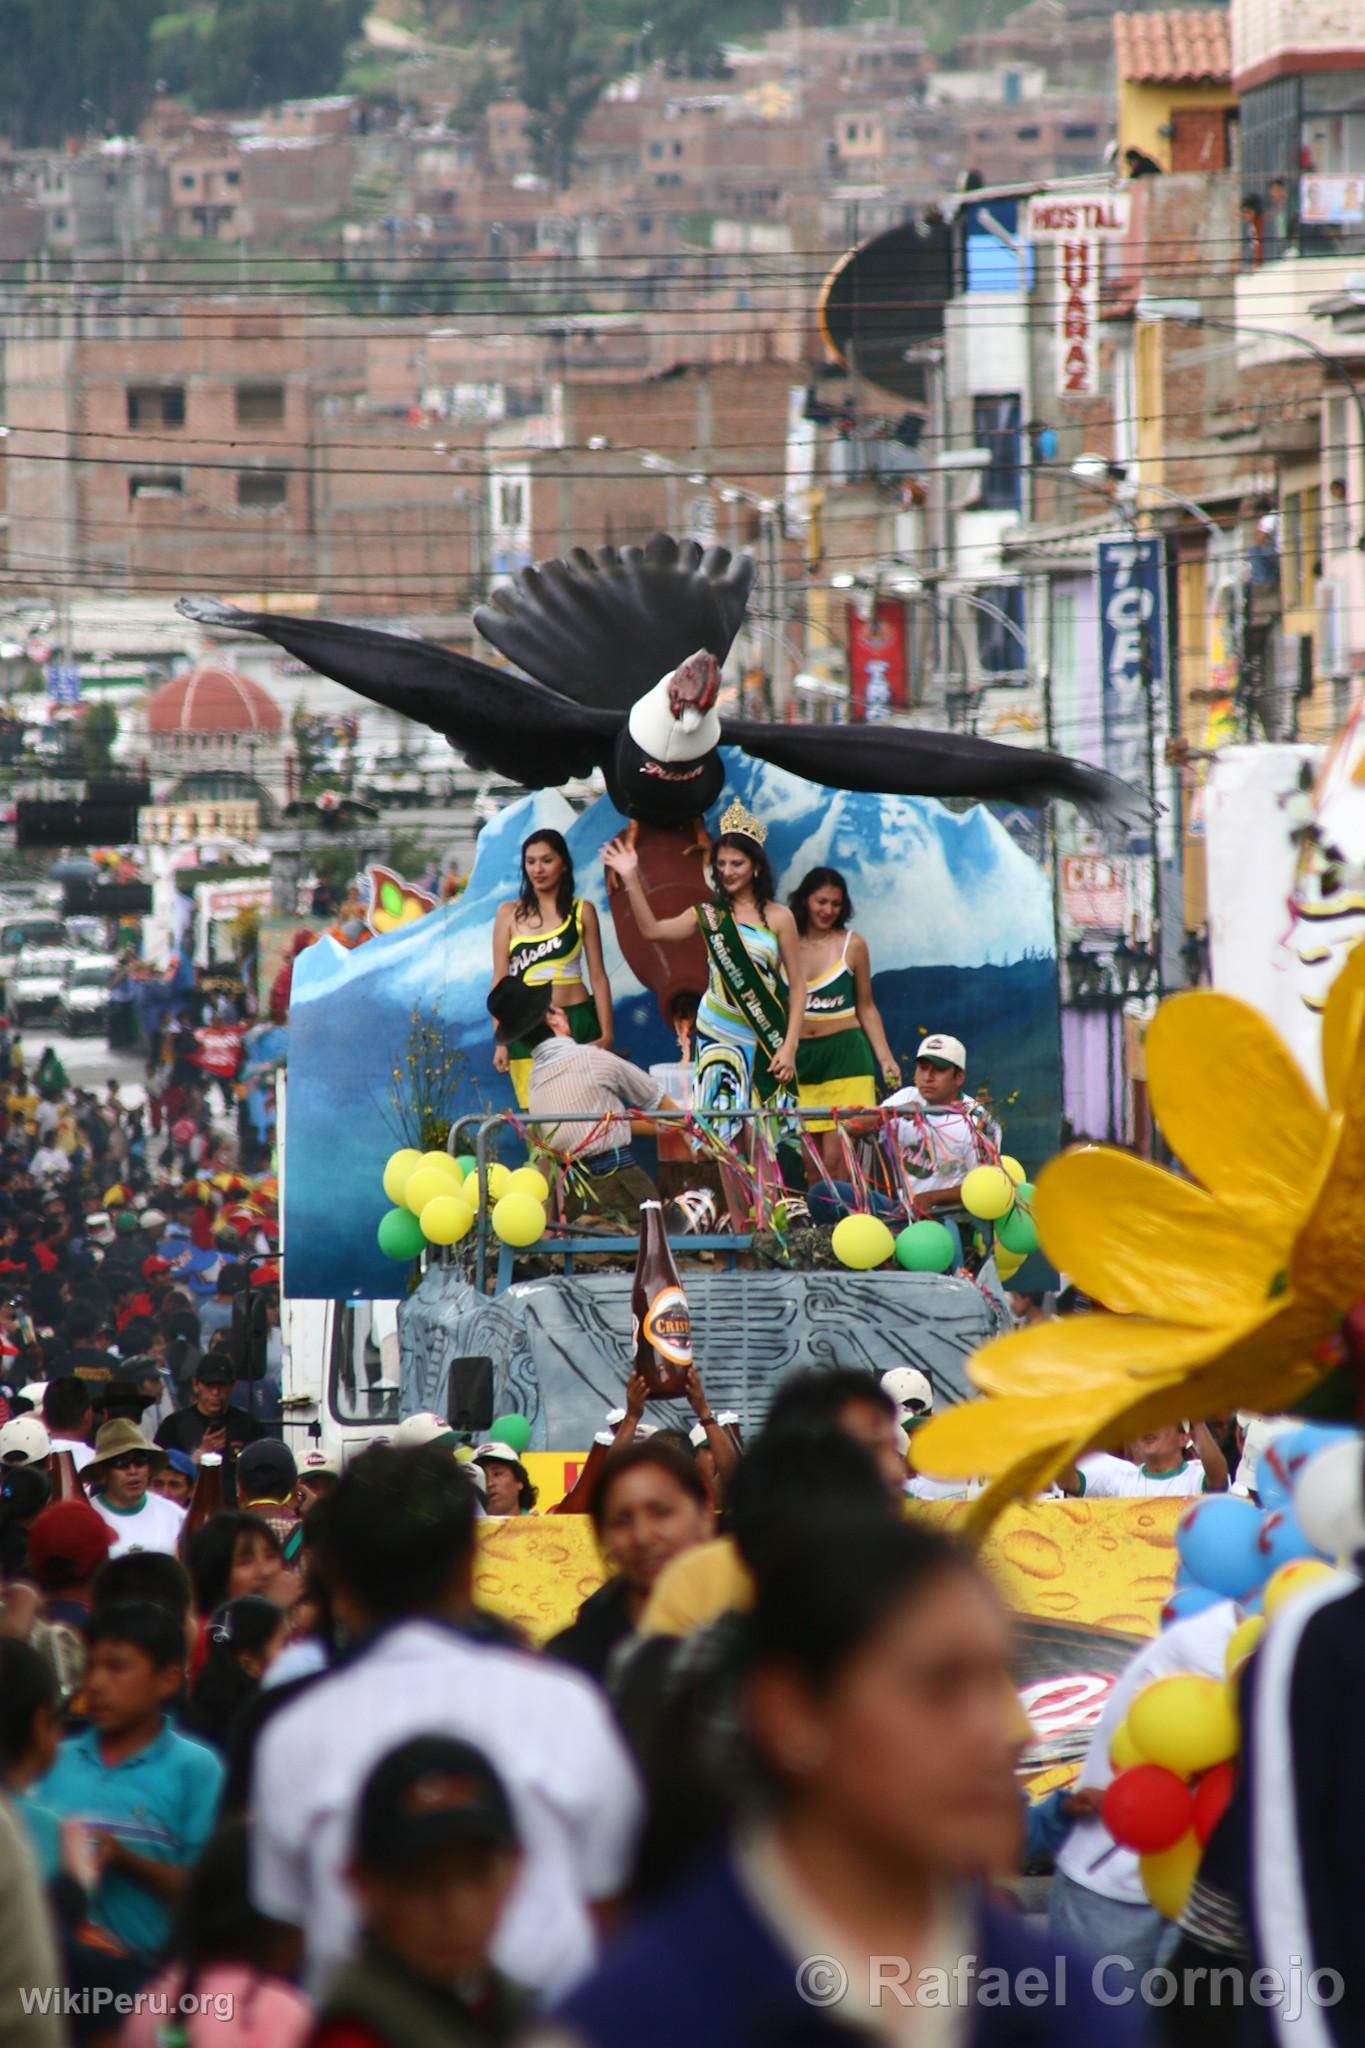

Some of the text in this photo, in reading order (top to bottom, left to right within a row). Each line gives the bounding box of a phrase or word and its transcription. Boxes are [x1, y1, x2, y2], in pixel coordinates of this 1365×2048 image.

[1033, 203, 1123, 229] HOSTAL
[1064, 239, 1089, 390] HUARAZ
[709, 932, 746, 990] Señorita
[740, 987, 773, 1033] Pilsen
